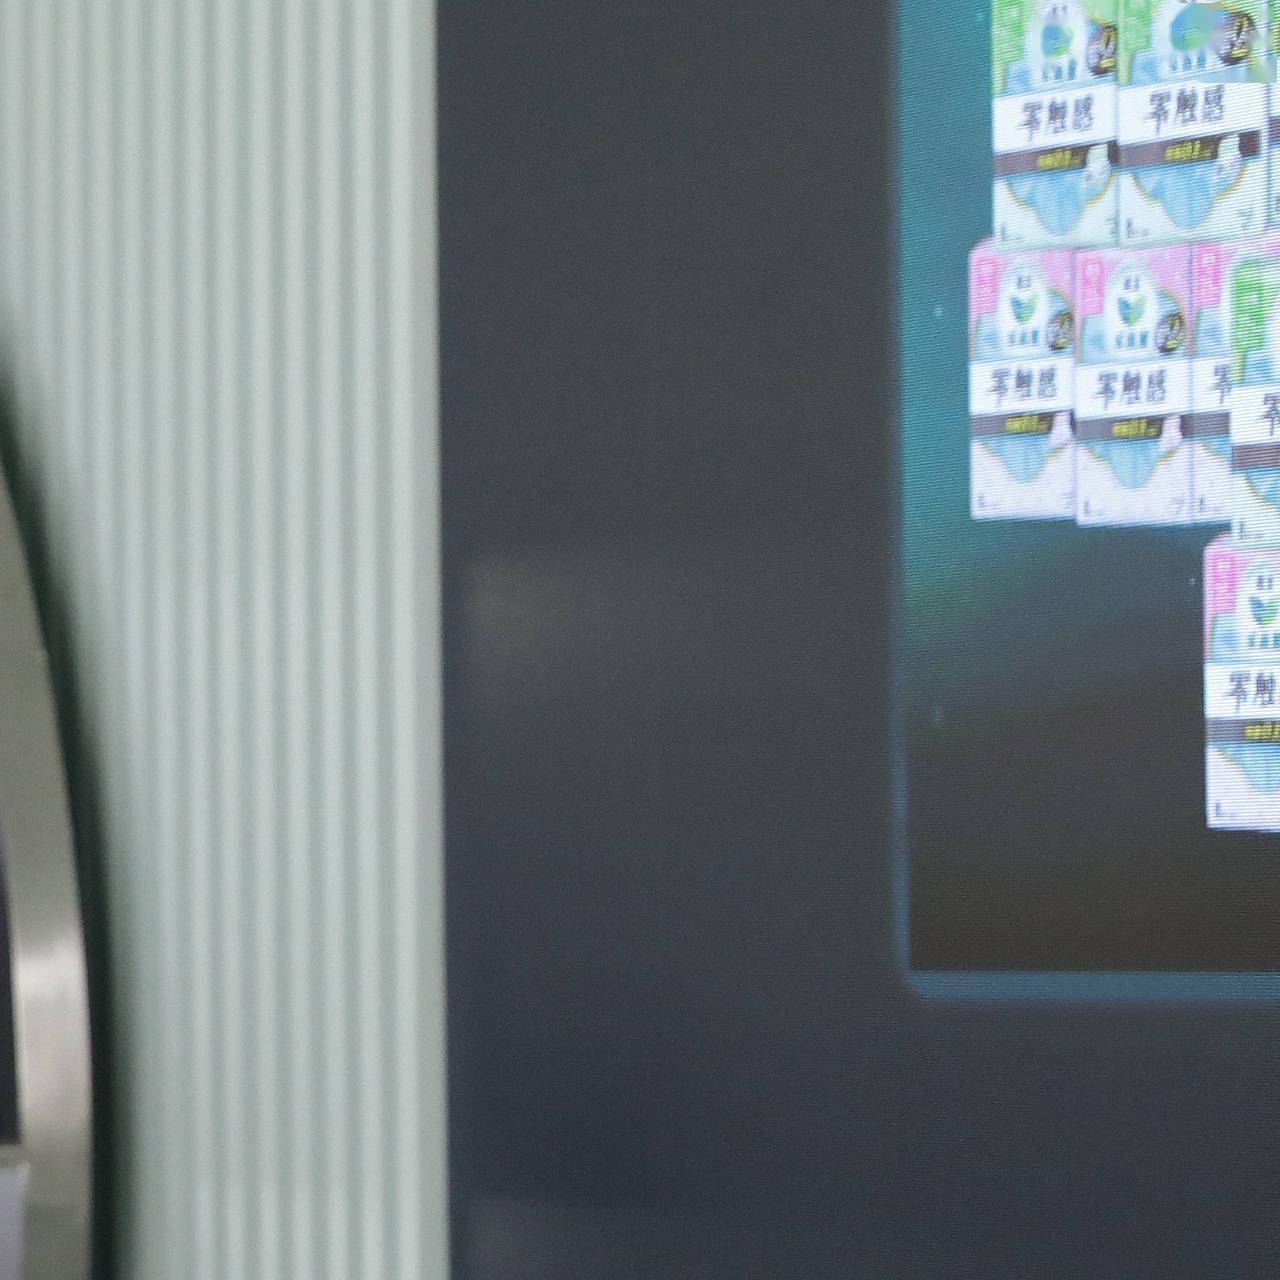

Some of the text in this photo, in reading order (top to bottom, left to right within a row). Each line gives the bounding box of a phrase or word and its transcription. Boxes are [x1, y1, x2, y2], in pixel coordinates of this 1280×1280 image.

[1018, 94, 1093, 140] 零触感
[1145, 84, 1223, 135] 零触感
[991, 366, 1057, 406] 零触感
[1096, 369, 1166, 410] 零触感
